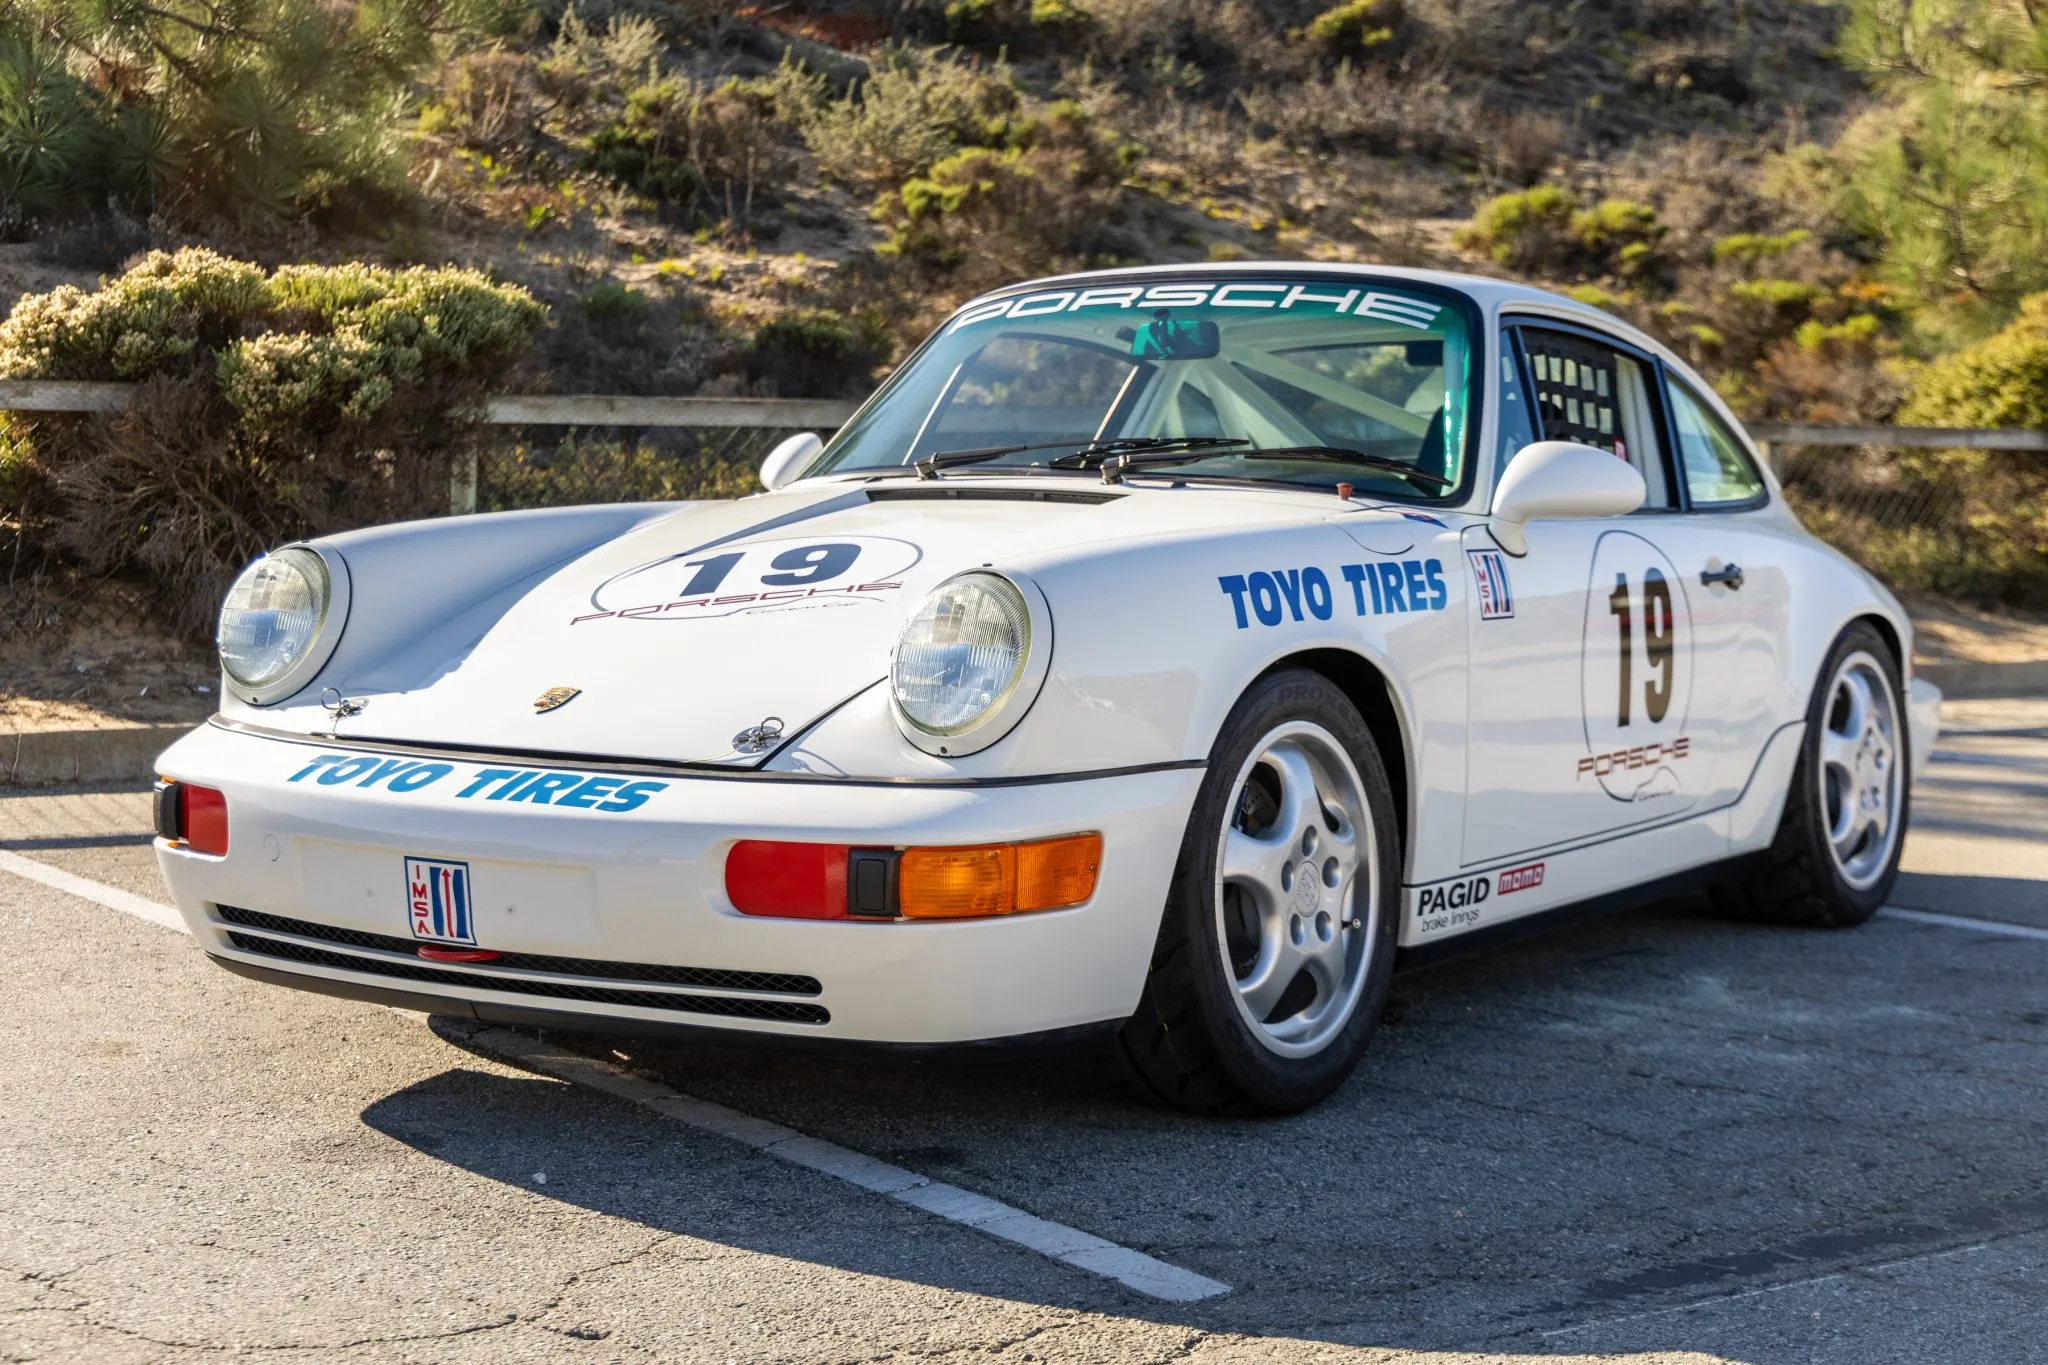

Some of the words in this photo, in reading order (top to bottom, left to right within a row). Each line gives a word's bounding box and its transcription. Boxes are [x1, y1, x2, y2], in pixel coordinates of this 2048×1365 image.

[947, 283, 1442, 335] PORSCHE
[680, 543, 862, 597] 19
[1217, 566, 1333, 629] TOYO
[1341, 558, 1447, 616] TIRES
[1471, 555, 1492, 615] IMSA
[570, 581, 903, 626] PORSCHE
[1608, 567, 1674, 727] 19
[287, 754, 455, 793] TOYO
[455, 768, 671, 813] TIRES
[1576, 737, 1690, 781] PORSCHE
[411, 864, 432, 935] IMSA
[1417, 877, 1490, 916] PAGID
[1421, 915, 1449, 932] brake
[1451, 909, 1480, 925] linings
